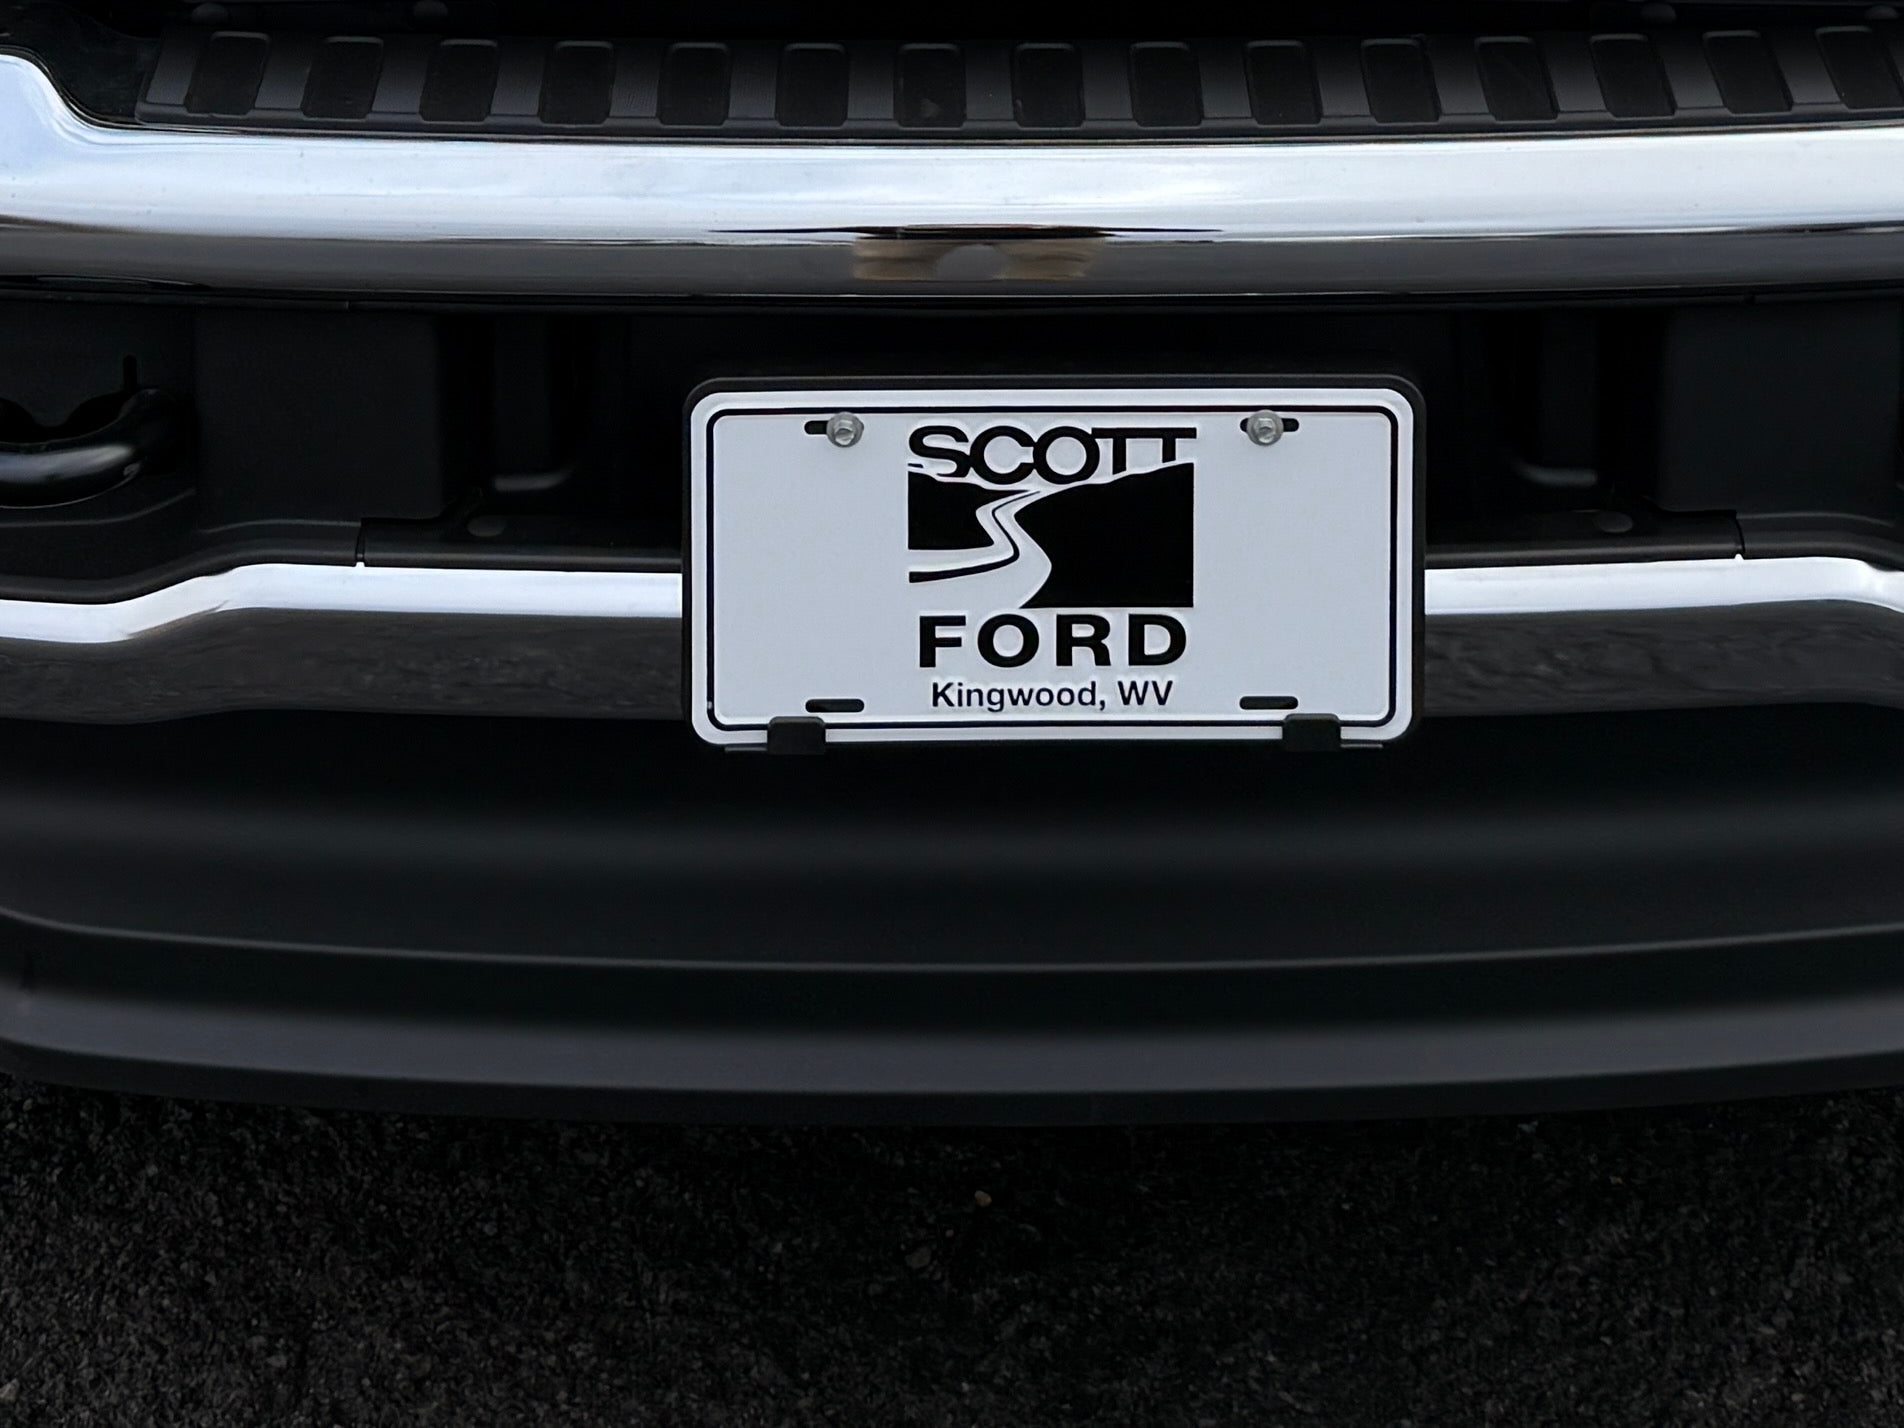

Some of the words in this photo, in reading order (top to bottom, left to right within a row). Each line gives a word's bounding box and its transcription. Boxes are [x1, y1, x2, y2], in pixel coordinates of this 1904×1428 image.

[908, 425, 1197, 485] SCOTT
[919, 614, 1188, 668] FORD
[930, 680, 1106, 713] Kingwood,
[1117, 680, 1175, 707] WV
